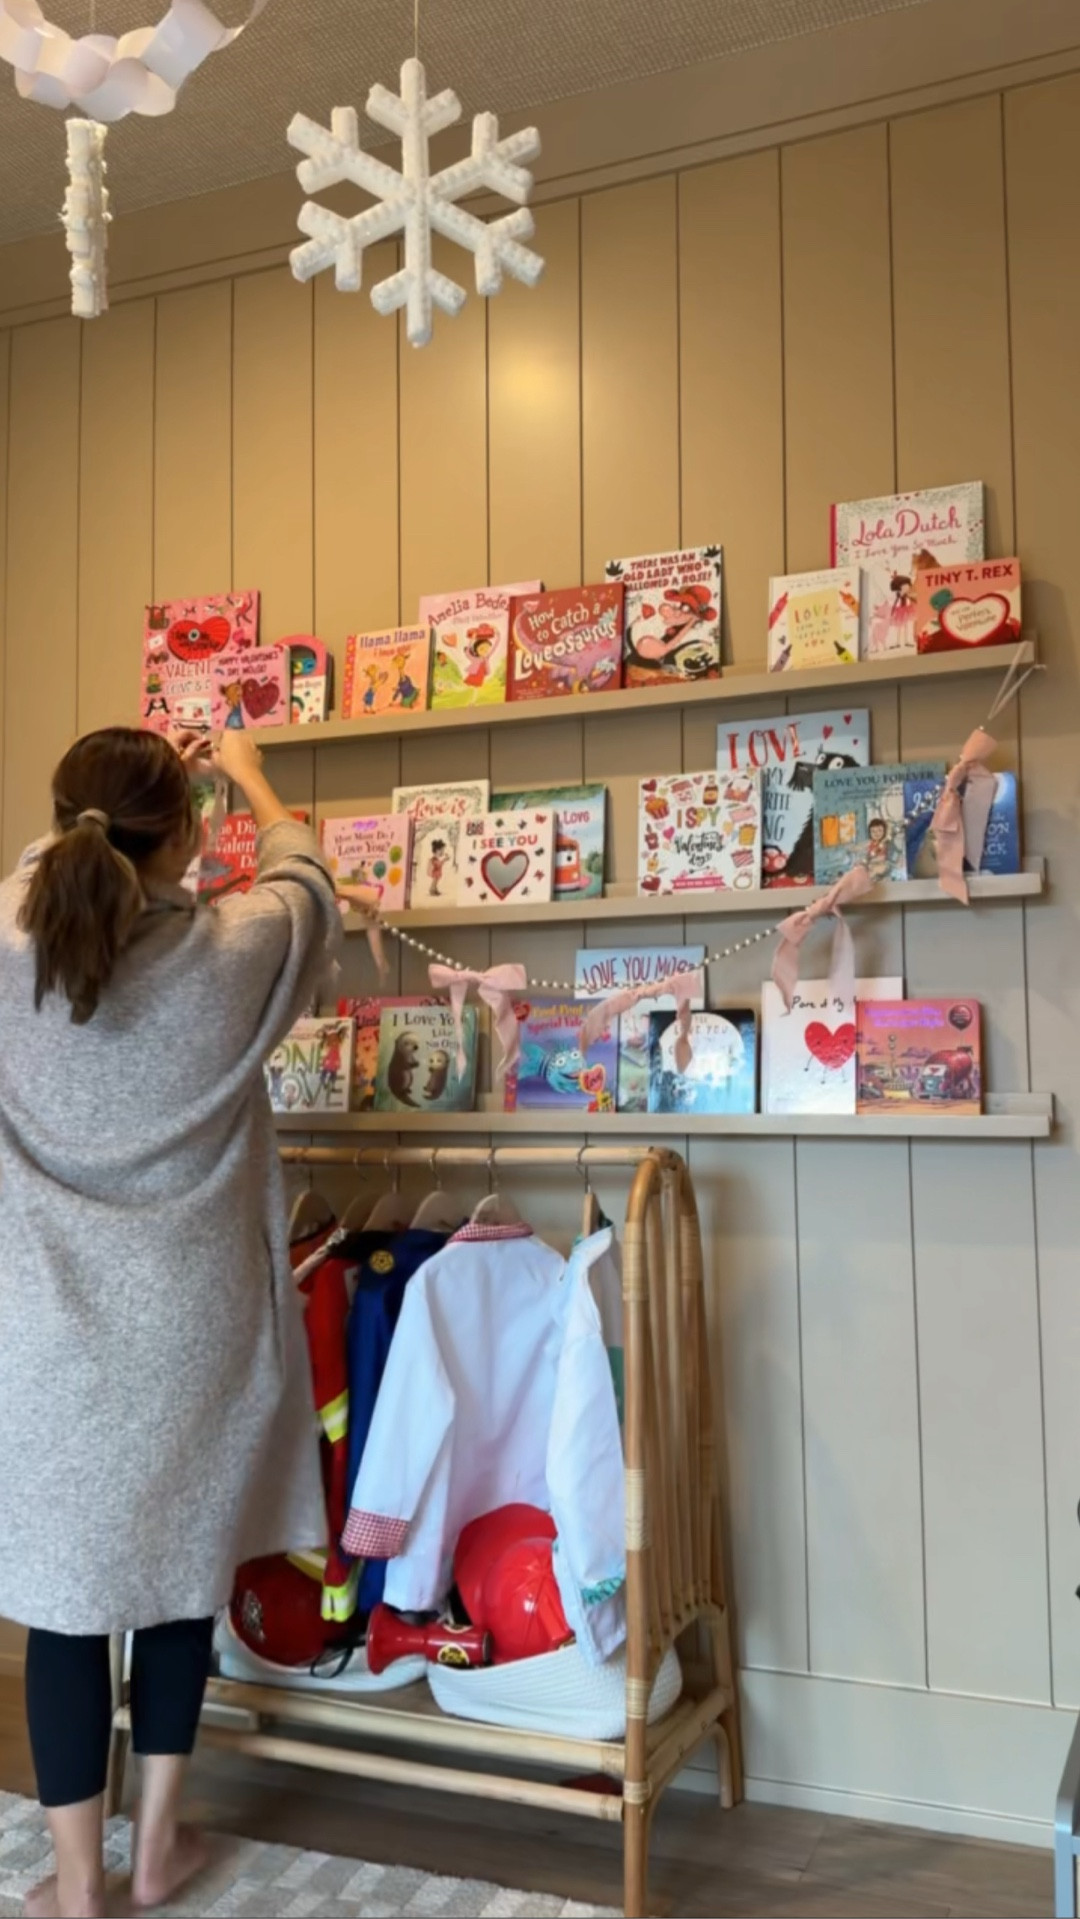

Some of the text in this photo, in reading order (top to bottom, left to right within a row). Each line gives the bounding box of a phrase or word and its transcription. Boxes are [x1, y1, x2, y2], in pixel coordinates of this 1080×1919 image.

[852, 505, 962, 547] Lola Dutch
[623, 561, 702, 583] OLD LADY WHO
[630, 551, 696, 571] THERE WAS AN
[625, 579, 670, 593] ALLOWED
[672, 576, 679, 586] A
[925, 563, 1013, 588] TINY T. REX
[428, 598, 471, 626] Amelia
[528, 602, 601, 642] How to Catch a
[360, 630, 426, 649] llama llama
[514, 621, 617, 682] Loveosaurus
[727, 720, 807, 770] LOVE
[824, 770, 935, 789] LOVE YOU FOREVER
[677, 805, 721, 829] I SPY
[987, 822, 1010, 836] ON
[473, 833, 538, 850] I SEE YOU
[583, 957, 618, 995] LOVE
[622, 955, 652, 981] YOU
[393, 1013, 398, 1027] I
[404, 1011, 436, 1026] Love
[440, 1012, 464, 1027] Yo
